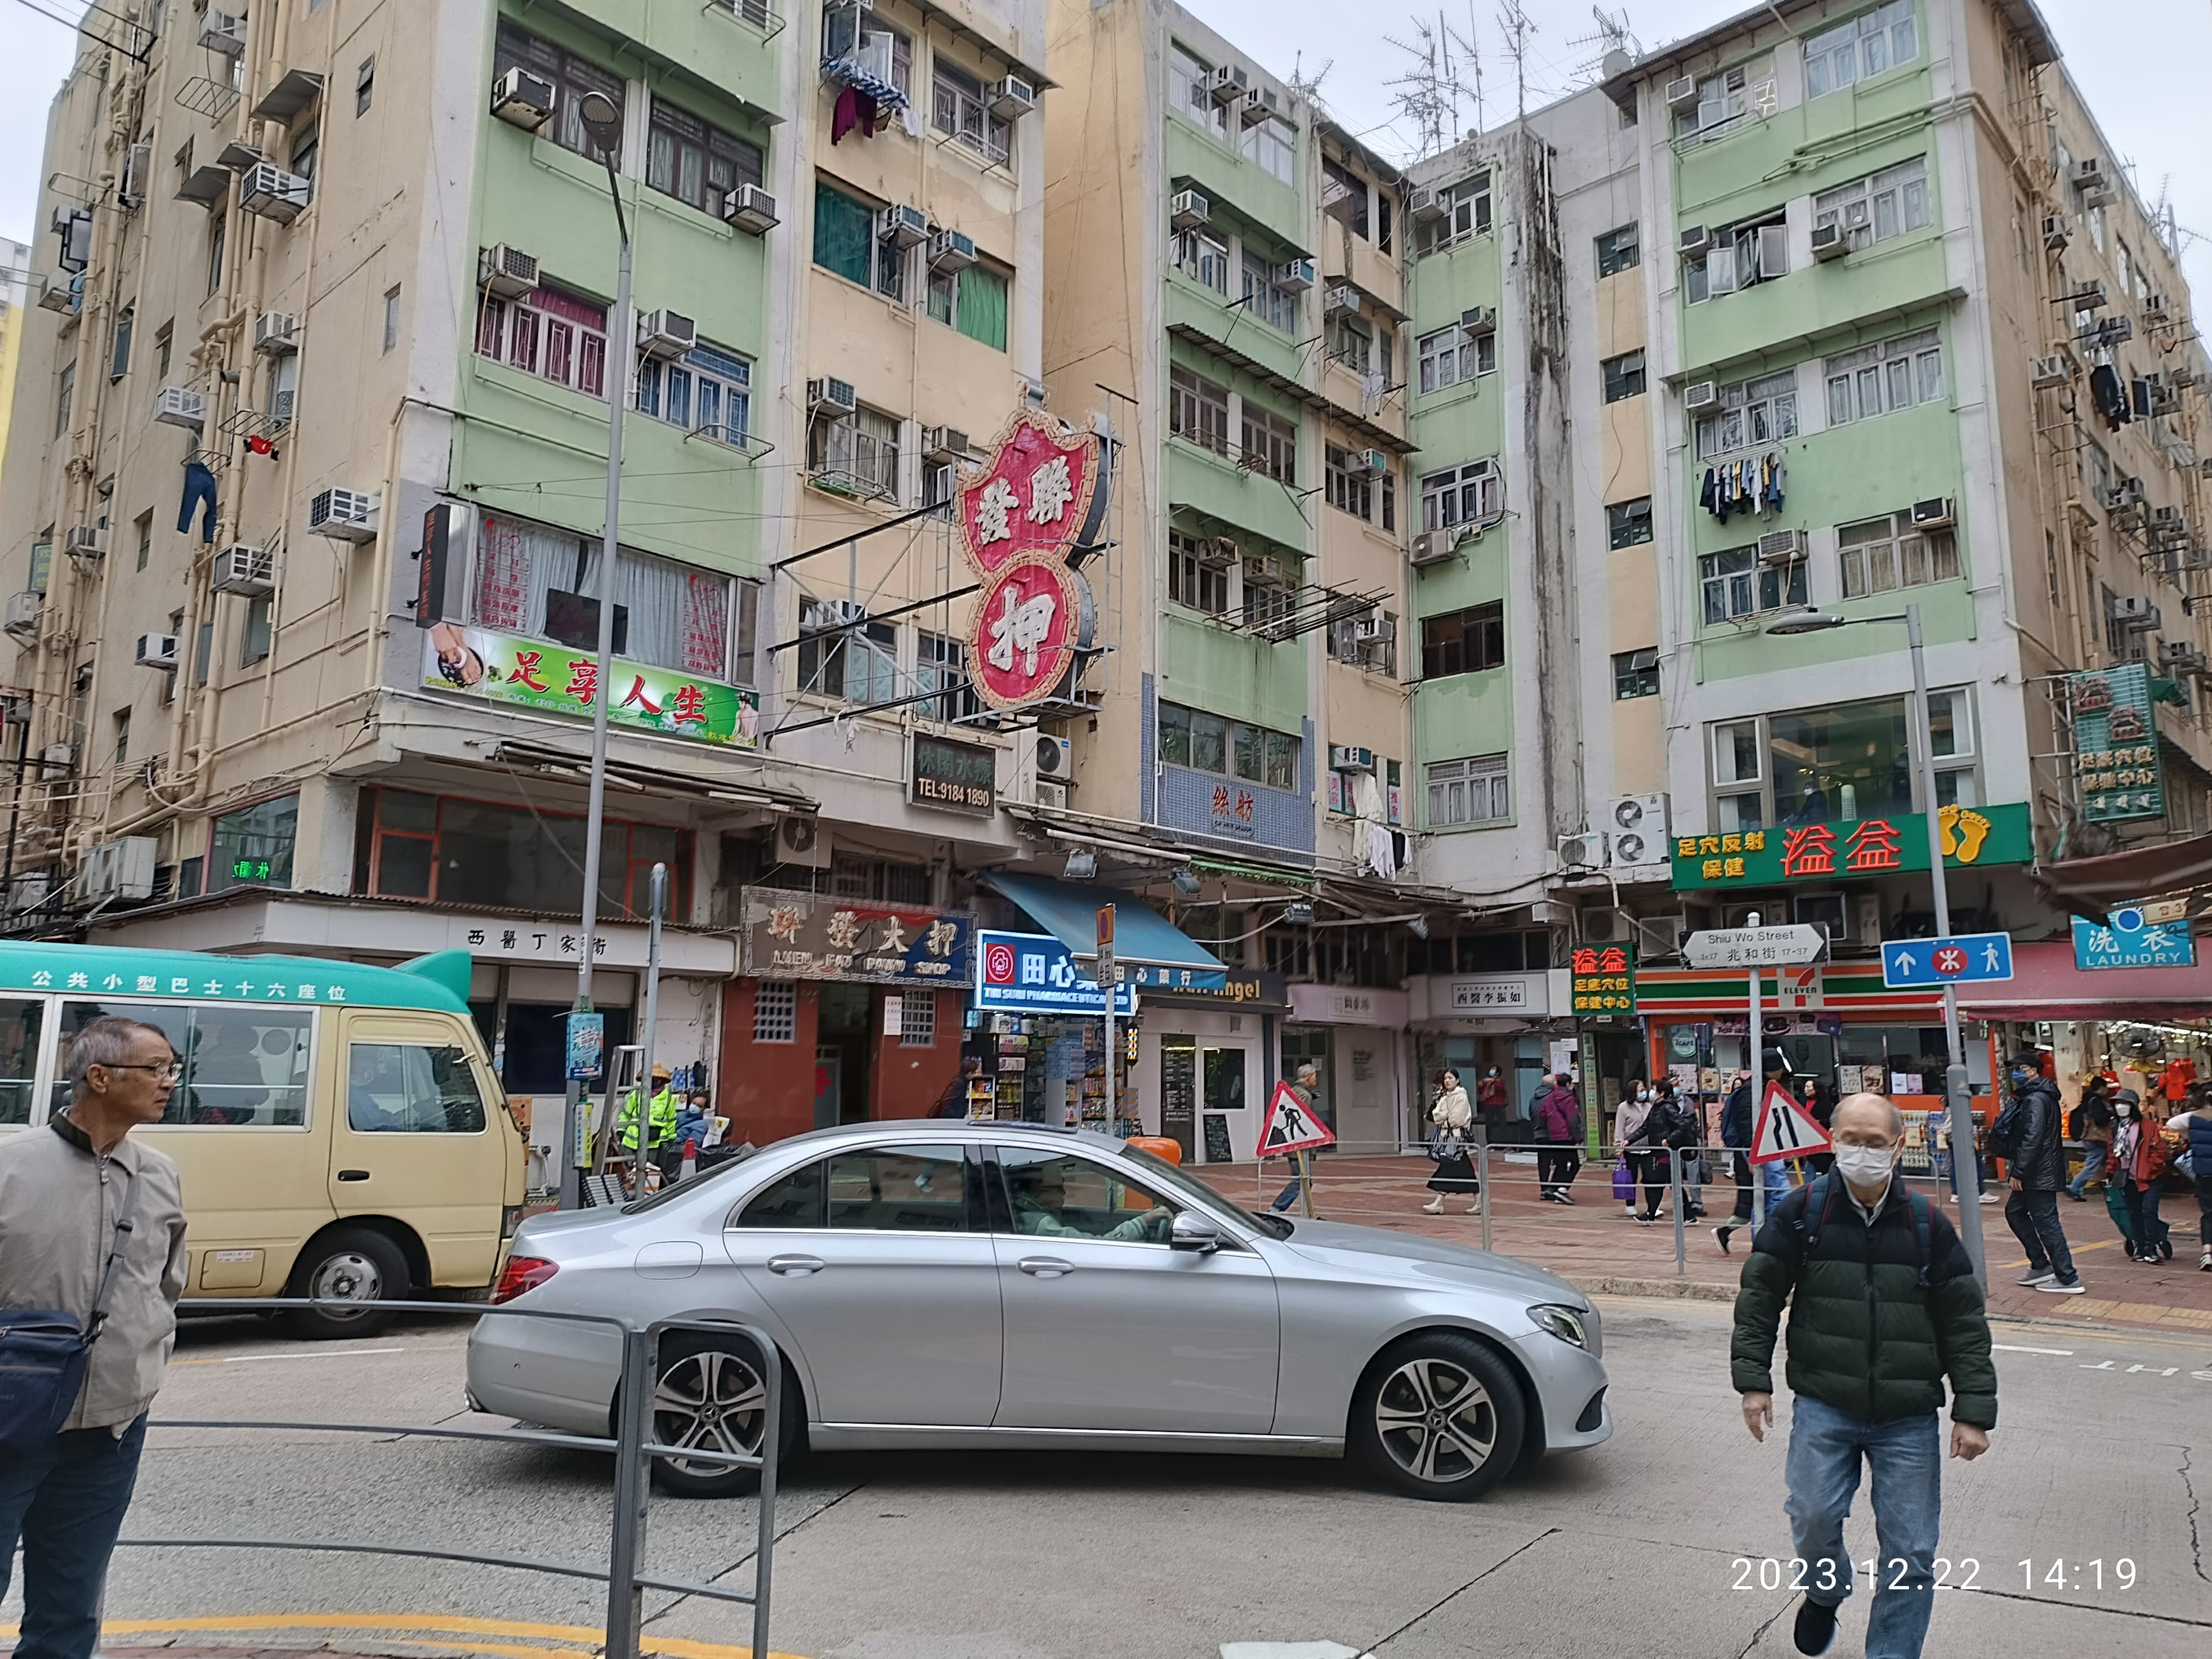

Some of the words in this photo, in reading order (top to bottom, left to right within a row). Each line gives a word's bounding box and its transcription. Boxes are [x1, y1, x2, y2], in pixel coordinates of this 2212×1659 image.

[987, 585, 1056, 677] 押
[507, 650, 710, 725] 足享人生
[918, 777, 964, 803] TEL:9184
[966, 787, 989, 807] 1890
[1677, 831, 1765, 858] 足穴反射
[1781, 819, 1902, 877] 溢益
[1702, 857, 1745, 880] 保健
[1708, 934, 1731, 945] Shiu
[1735, 933, 1753, 942] Wo
[1758, 930, 1794, 941] Street
[2088, 925, 2176, 954] 洗衣
[1572, 946, 1627, 975] 溢益
[1728, 946, 1776, 962] 兆和街
[2086, 952, 2181, 966] LAUNDRY
[914, 960, 952, 976] SHOP
[31, 970, 347, 1002] 公共小型巴士十六座位
[1213, 979, 1260, 1002] ngel
[1574, 976, 1630, 993] 足底穴位
[1574, 995, 1631, 1010] 保健中心
